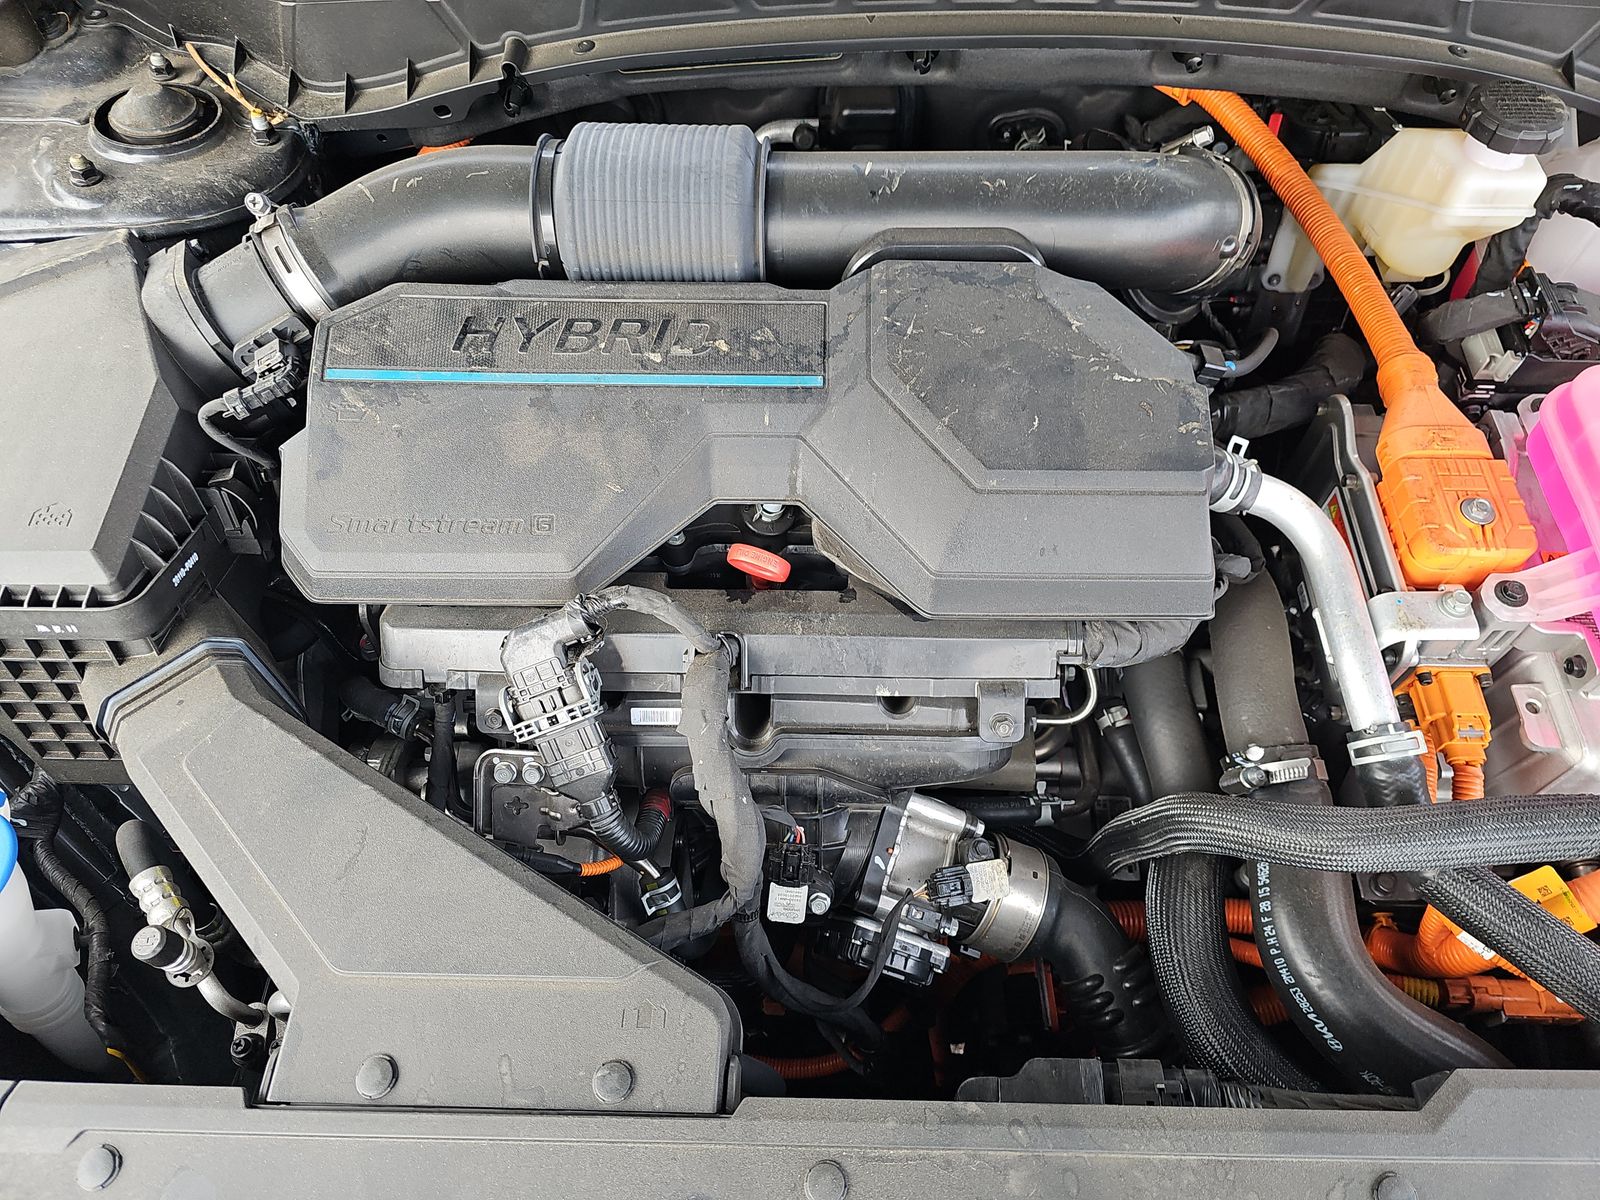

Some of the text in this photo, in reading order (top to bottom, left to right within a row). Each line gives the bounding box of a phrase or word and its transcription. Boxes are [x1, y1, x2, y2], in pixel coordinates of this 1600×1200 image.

[451, 315, 719, 355] HYBRID
[327, 513, 525, 534] Smartstream
[750, 550, 778, 568] ENGINE
[1274, 957, 1295, 985] 2M410
[1290, 987, 1314, 1014] 28253
